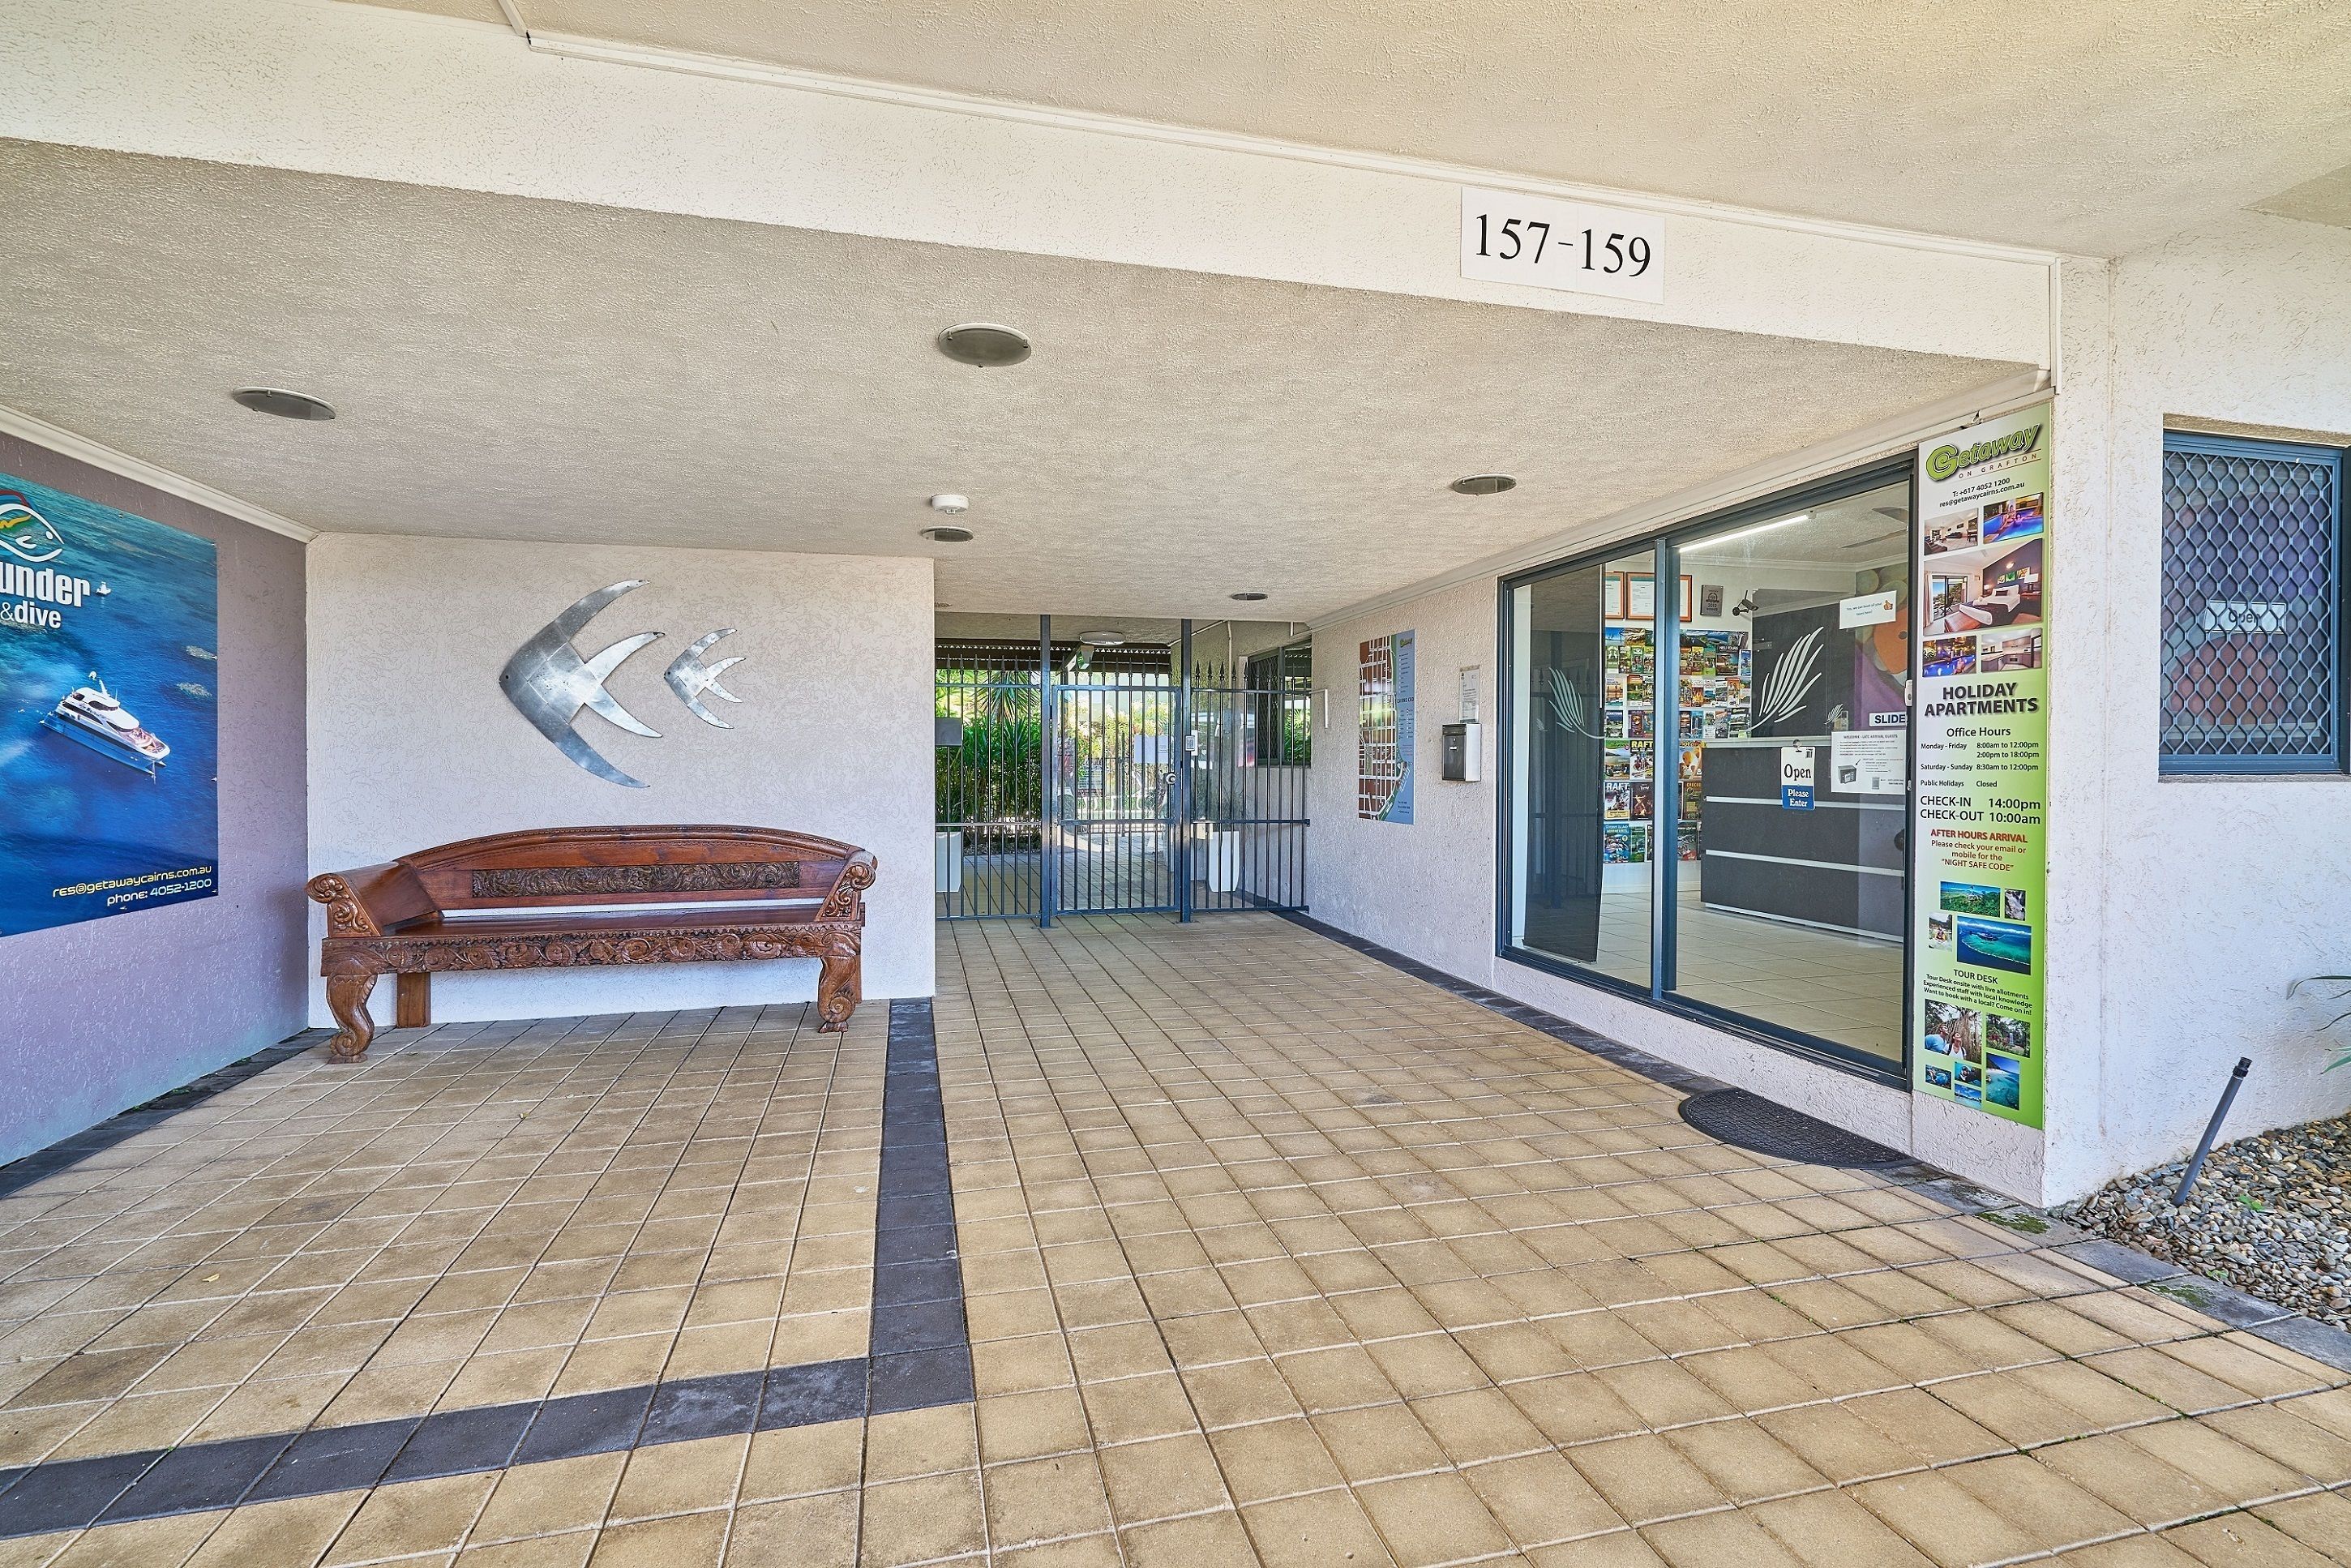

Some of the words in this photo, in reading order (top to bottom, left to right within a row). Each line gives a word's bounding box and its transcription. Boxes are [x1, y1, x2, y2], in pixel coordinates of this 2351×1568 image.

[1925, 423, 2041, 481] Getaway
[1959, 471, 1972, 479] ON
[1981, 453, 2036, 473] GRAFTON
[1959, 486, 1975, 495] +617
[1976, 482, 1992, 491] 4052
[1994, 478, 2010, 486] 1200
[1939, 482, 2025, 508] res@getawaycairns.com.au
[1942, 683, 2017, 700] HOLIDAY
[1925, 698, 2038, 716] APARTMENTS
[1874, 714, 1905, 723] SLIDE
[1946, 728, 1976, 737] Office
[1979, 727, 2011, 736] Hours
[1784, 764, 1811, 781] Open
[1788, 789, 1809, 797] Please
[1790, 799, 1807, 807] Enter
[1921, 796, 1971, 807] CHECK-IN
[1989, 799, 2041, 811] 14:00pm
[1921, 809, 1984, 821] CHECK-OUT
[1989, 812, 2041, 824] 10:00am
[1931, 829, 1955, 838] AFTER
[1958, 831, 1987, 840] HOURS
[1989, 834, 2028, 843] ARRIVAL
[1931, 840, 1953, 848] Please
[52, 865, 212, 898] res@getawaycairns.com.au
[106, 890, 148, 906] phone:
[150, 878, 212, 897] 4052-1200
[1954, 969, 1976, 980] TOUR
[1976, 975, 1998, 984] DESK
[1923, 980, 1955, 992] Experienced
[1999, 996, 2032, 1009] knowledge
[1997, 989, 2028, 1000] allotments
[1978, 999, 1994, 1007] local?
[1996, 1003, 2013, 1011] Come
